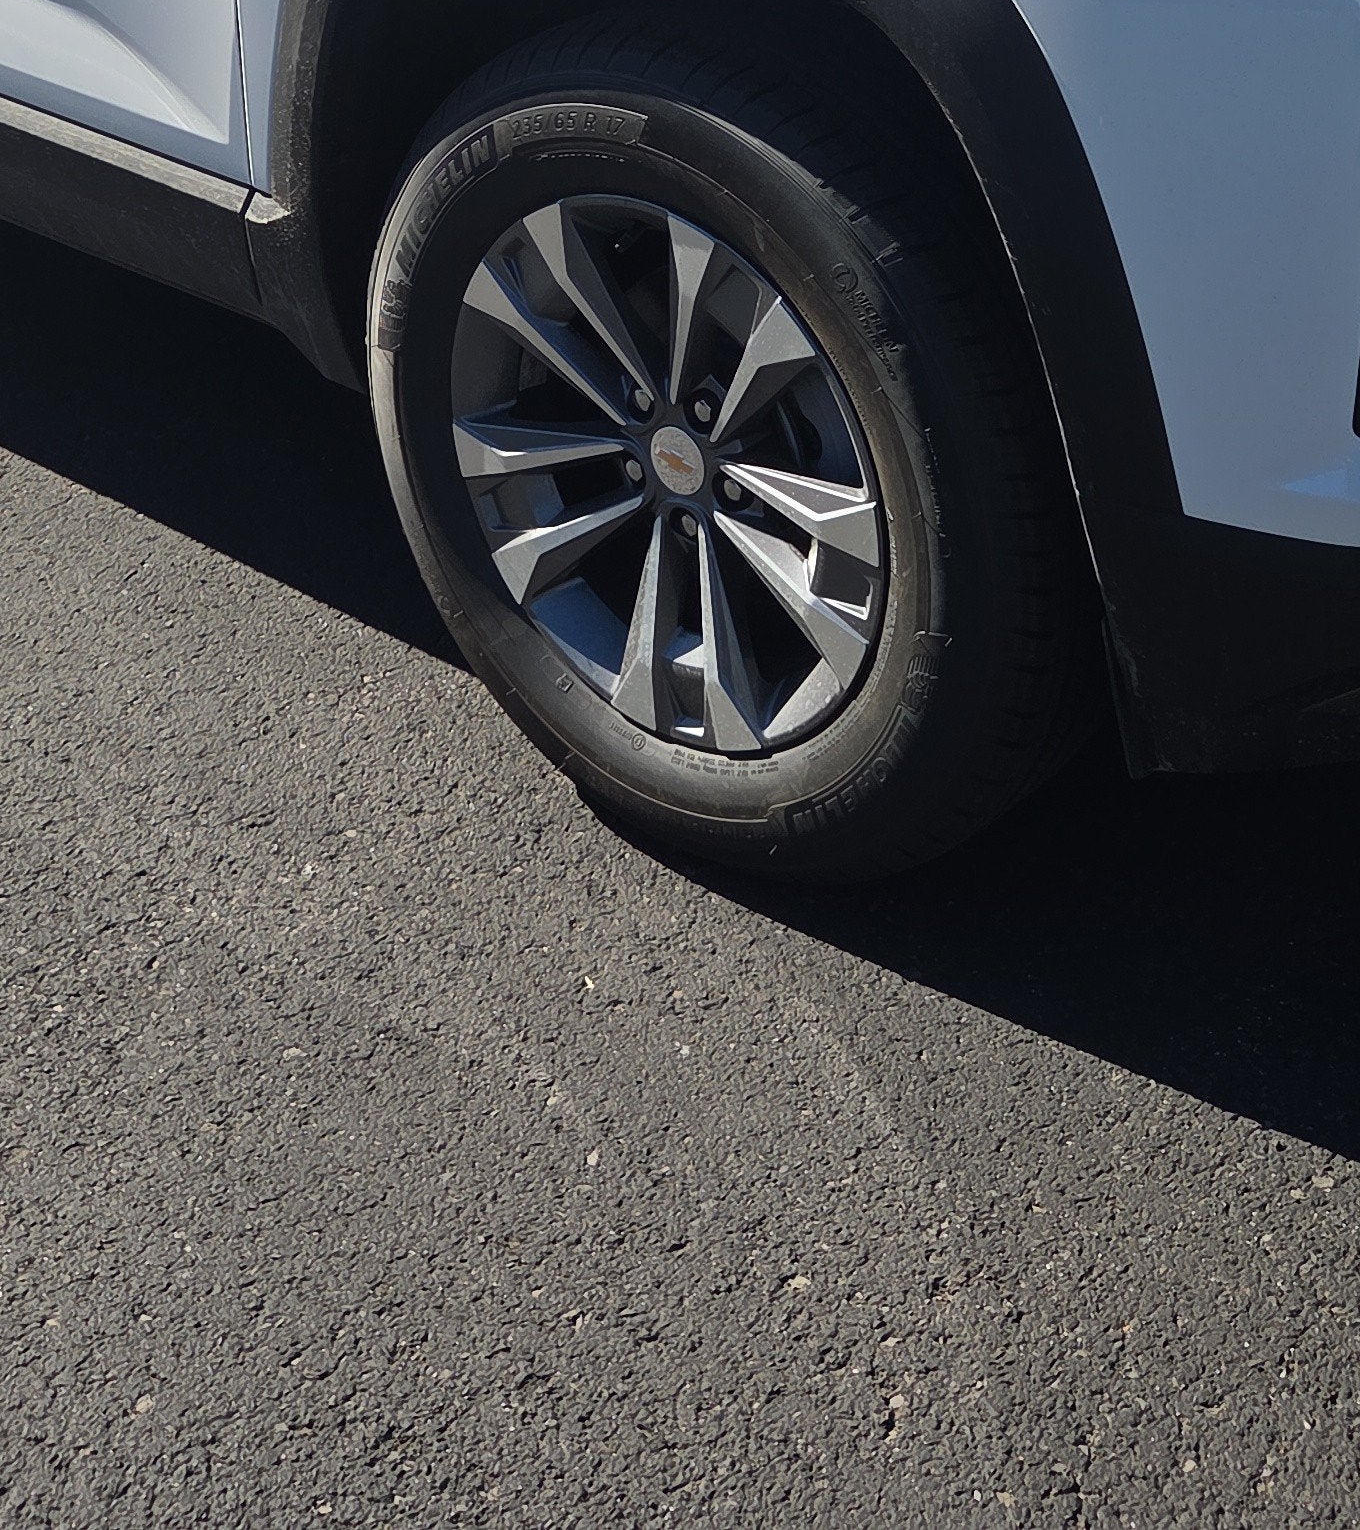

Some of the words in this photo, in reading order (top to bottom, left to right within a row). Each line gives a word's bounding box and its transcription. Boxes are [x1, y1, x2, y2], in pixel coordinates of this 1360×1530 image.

[510, 110, 578, 140] 235/65
[582, 111, 597, 133] R
[605, 114, 627, 137] 17
